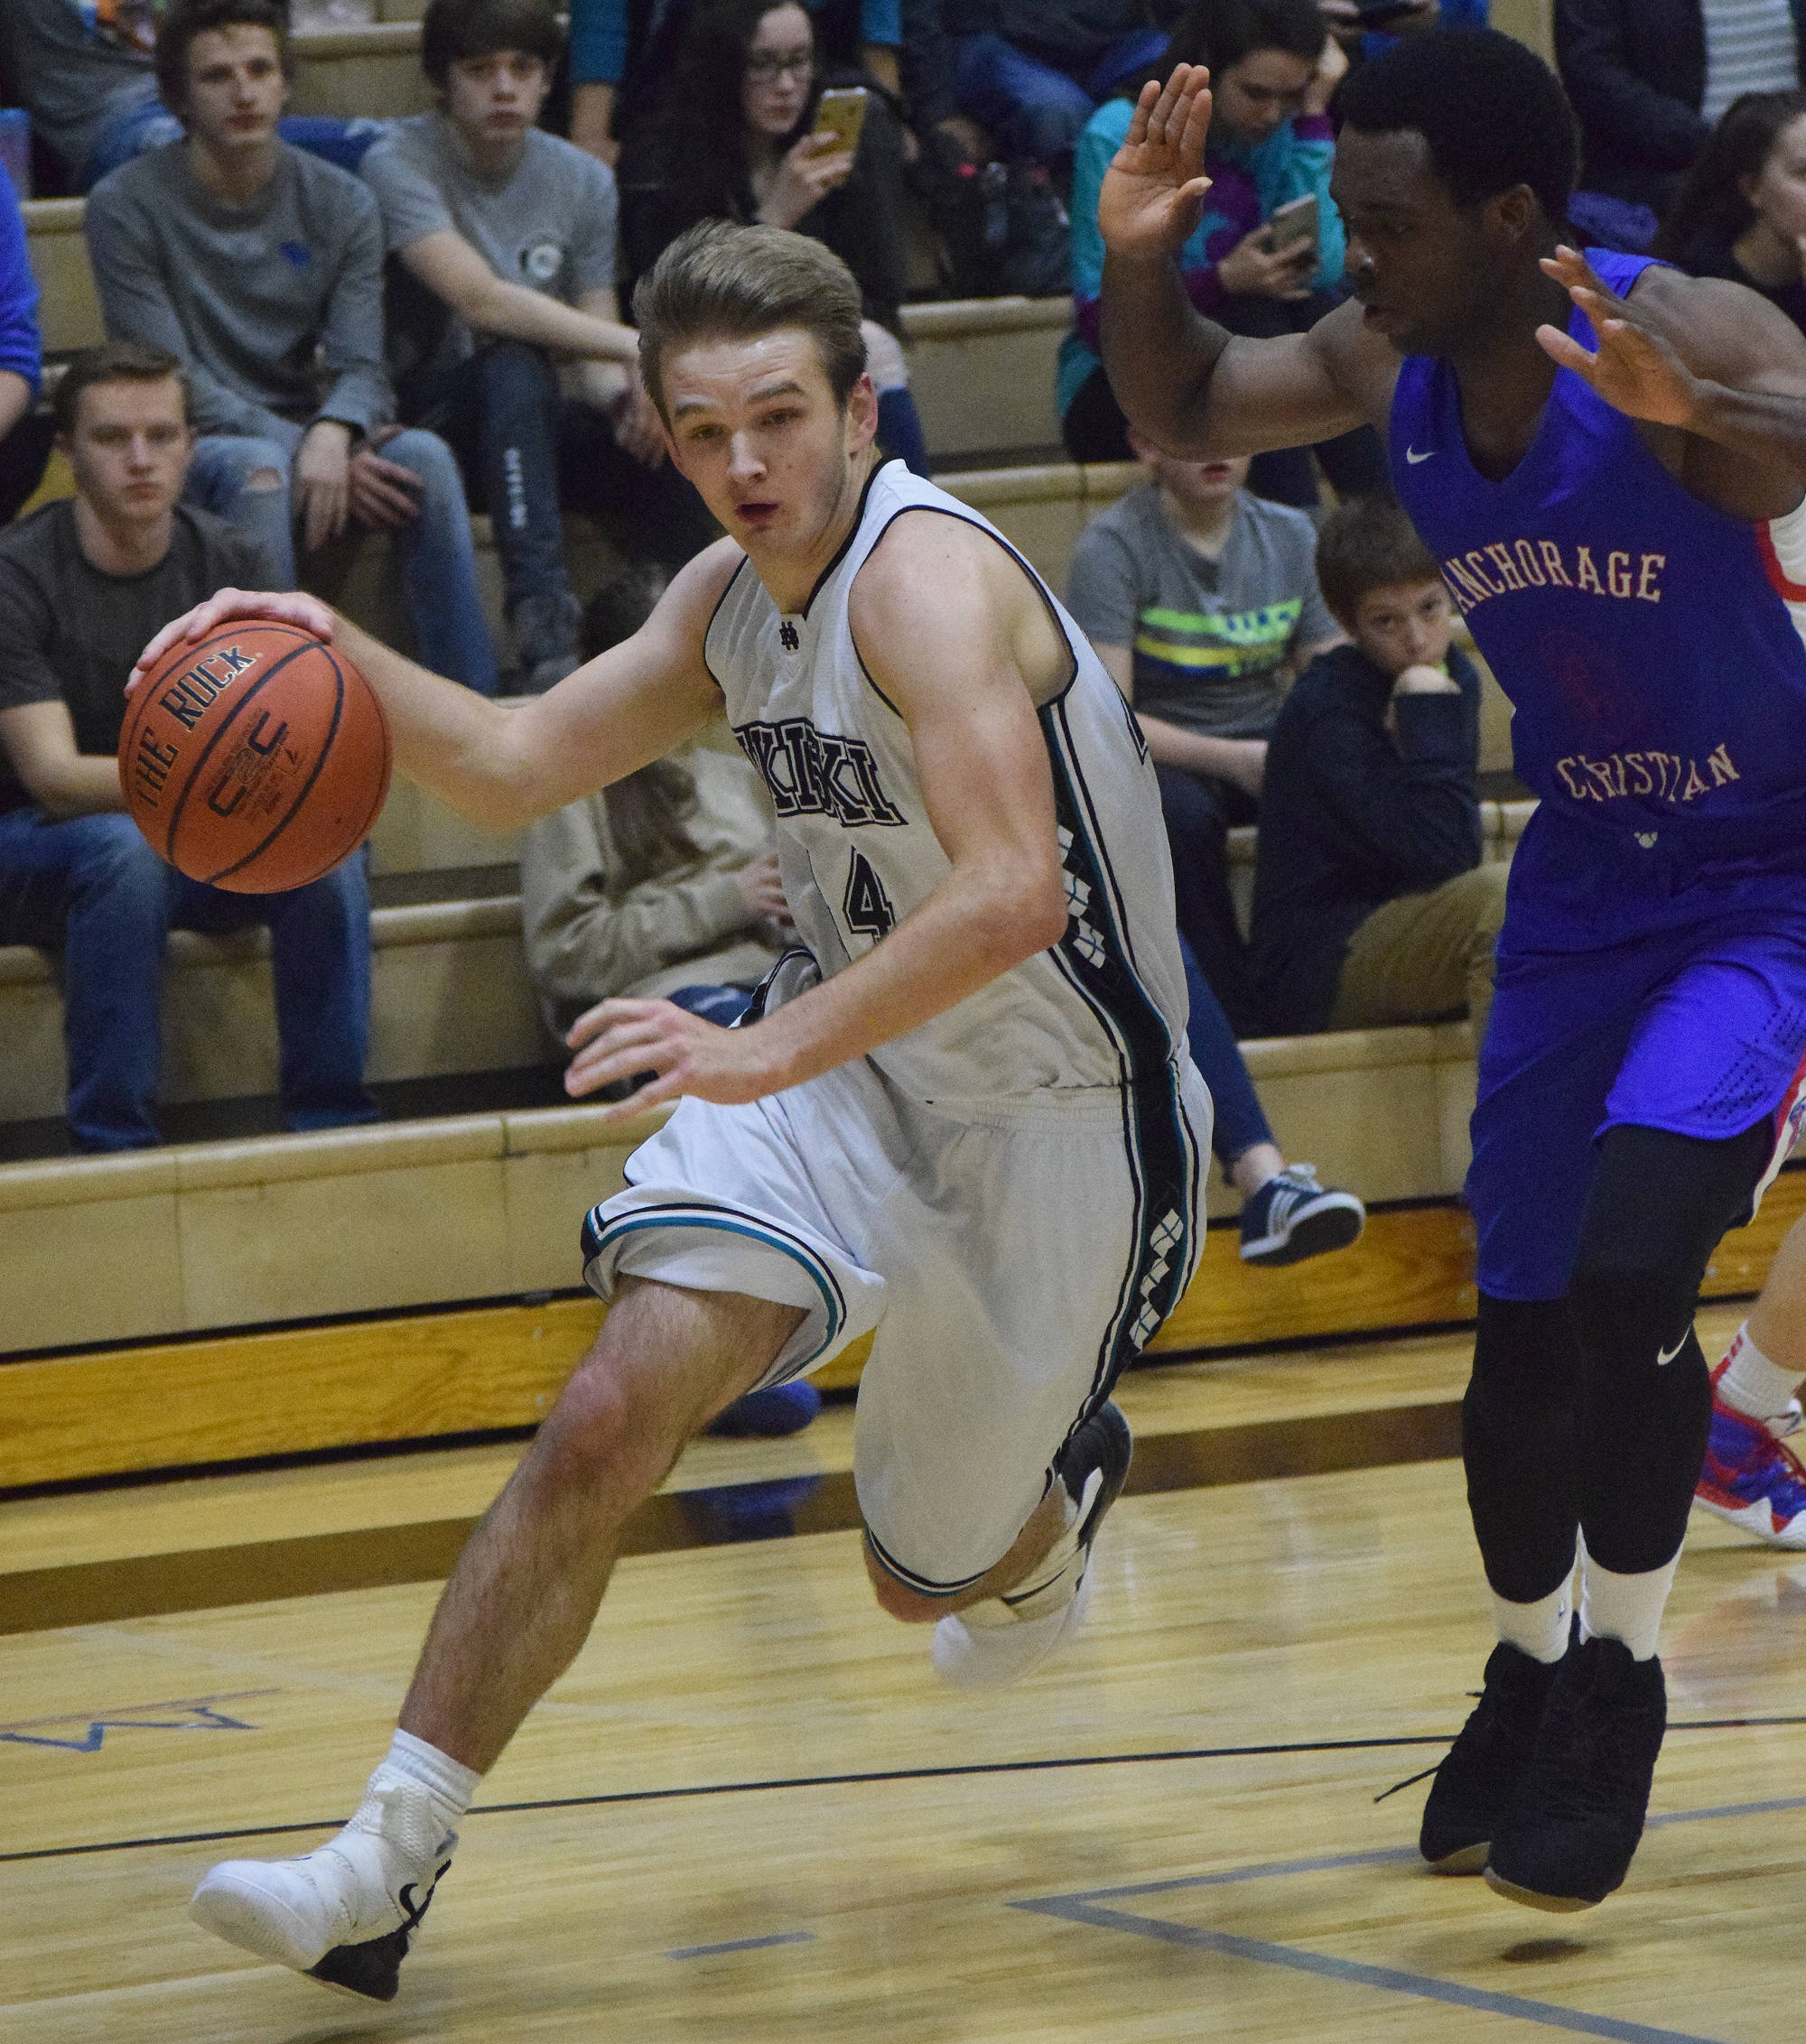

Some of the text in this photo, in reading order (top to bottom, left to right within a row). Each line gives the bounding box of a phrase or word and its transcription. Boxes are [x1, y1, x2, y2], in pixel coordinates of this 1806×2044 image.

[1438, 538, 1666, 616] ANCHORAGE
[135, 646, 256, 809] THE ROCK
[842, 844, 898, 945] 4
